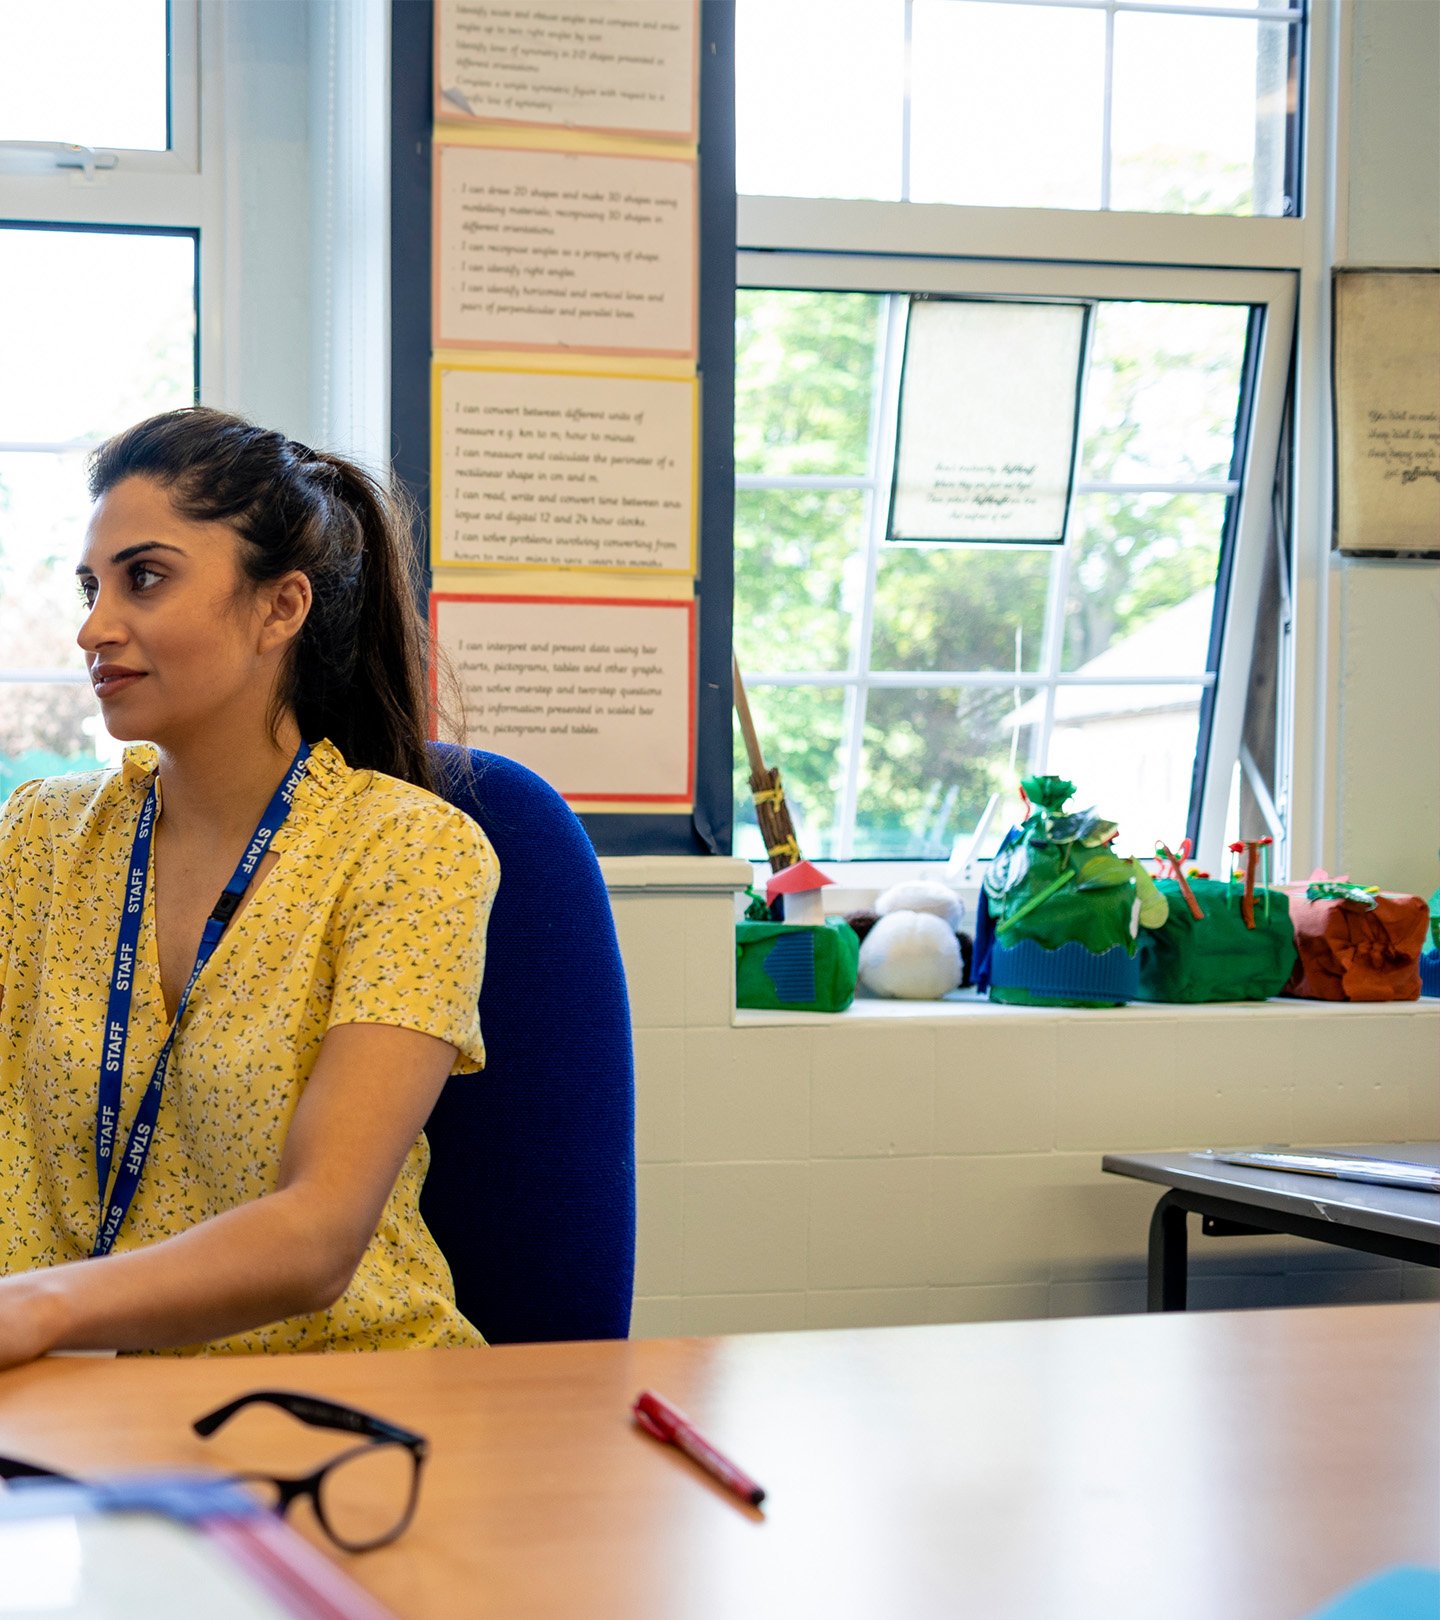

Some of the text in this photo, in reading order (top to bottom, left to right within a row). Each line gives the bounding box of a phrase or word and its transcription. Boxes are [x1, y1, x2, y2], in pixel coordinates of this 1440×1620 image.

[462, 405, 480, 414] can
[483, 406, 520, 415] convert
[522, 407, 561, 417] between
[564, 407, 605, 422] different
[607, 411, 631, 421] units
[633, 410, 643, 425] of
[454, 427, 495, 436] measure
[517, 428, 534, 437] km
[535, 429, 547, 439] to
[563, 430, 587, 440] hour
[589, 431, 601, 441] to
[462, 449, 480, 457] can
[482, 450, 523, 459] measure
[526, 450, 545, 460] and
[547, 451, 590, 462] calculate
[592, 452, 607, 463] the
[609, 456, 653, 466] perimeter
[656, 455, 666, 470] of
[454, 467, 502, 478] rectilinear
[505, 469, 534, 482] shape
[537, 472, 547, 480] in
[549, 472, 563, 481] cm
[566, 472, 585, 482] and
[462, 491, 479, 500] can
[482, 490, 506, 501] read,
[510, 492, 534, 502] write
[537, 492, 557, 503] and
[559, 495, 595, 504] convert
[597, 496, 618, 506] time
[620, 497, 659, 507] between
[454, 509, 480, 523] logue
[483, 510, 502, 521] and
[505, 511, 536, 525] digital
[539, 511, 550, 523] 12
[553, 513, 572, 524] and
[575, 513, 588, 525] 24
[590, 515, 613, 525] hour
[461, 533, 479, 542] can
[481, 532, 507, 542] solve
[508, 533, 552, 546] problems
[555, 536, 600, 549] involving
[602, 539, 653, 550] converting
[653, 538, 676, 553] from
[465, 642, 483, 651] can
[486, 642, 527, 653] interpret
[530, 641, 549, 652] and
[551, 643, 586, 654] present
[588, 643, 610, 653] data
[613, 645, 639, 657] using
[641, 644, 657, 654] bar
[493, 662, 549, 675] pictograms,
[552, 661, 580, 672] tables
[582, 662, 601, 673] and
[604, 662, 627, 673] other
[465, 685, 483, 694] can
[485, 683, 511, 693] solve
[555, 683, 575, 694] and
[577, 686, 616, 696] two-step
[619, 687, 662, 698] questions
[486, 703, 543, 716] information
[546, 704, 591, 716] presented
[594, 705, 603, 715] in
[606, 704, 635, 715] scaled
[637, 705, 653, 716] bar
[492, 724, 546, 737] pictograms
[549, 723, 568, 734] and
[139, 796, 154, 839] STAFF
[242, 827, 272, 874] STAFF
[128, 868, 144, 913] STAFF
[116, 943, 133, 991] STAFF
[180, 959, 204, 1007] STAFF
[106, 1021, 124, 1072] STAFF
[153, 1041, 173, 1091] STAFF
[100, 1105, 116, 1158] STAFF
[126, 1123, 151, 1176] STAFF
